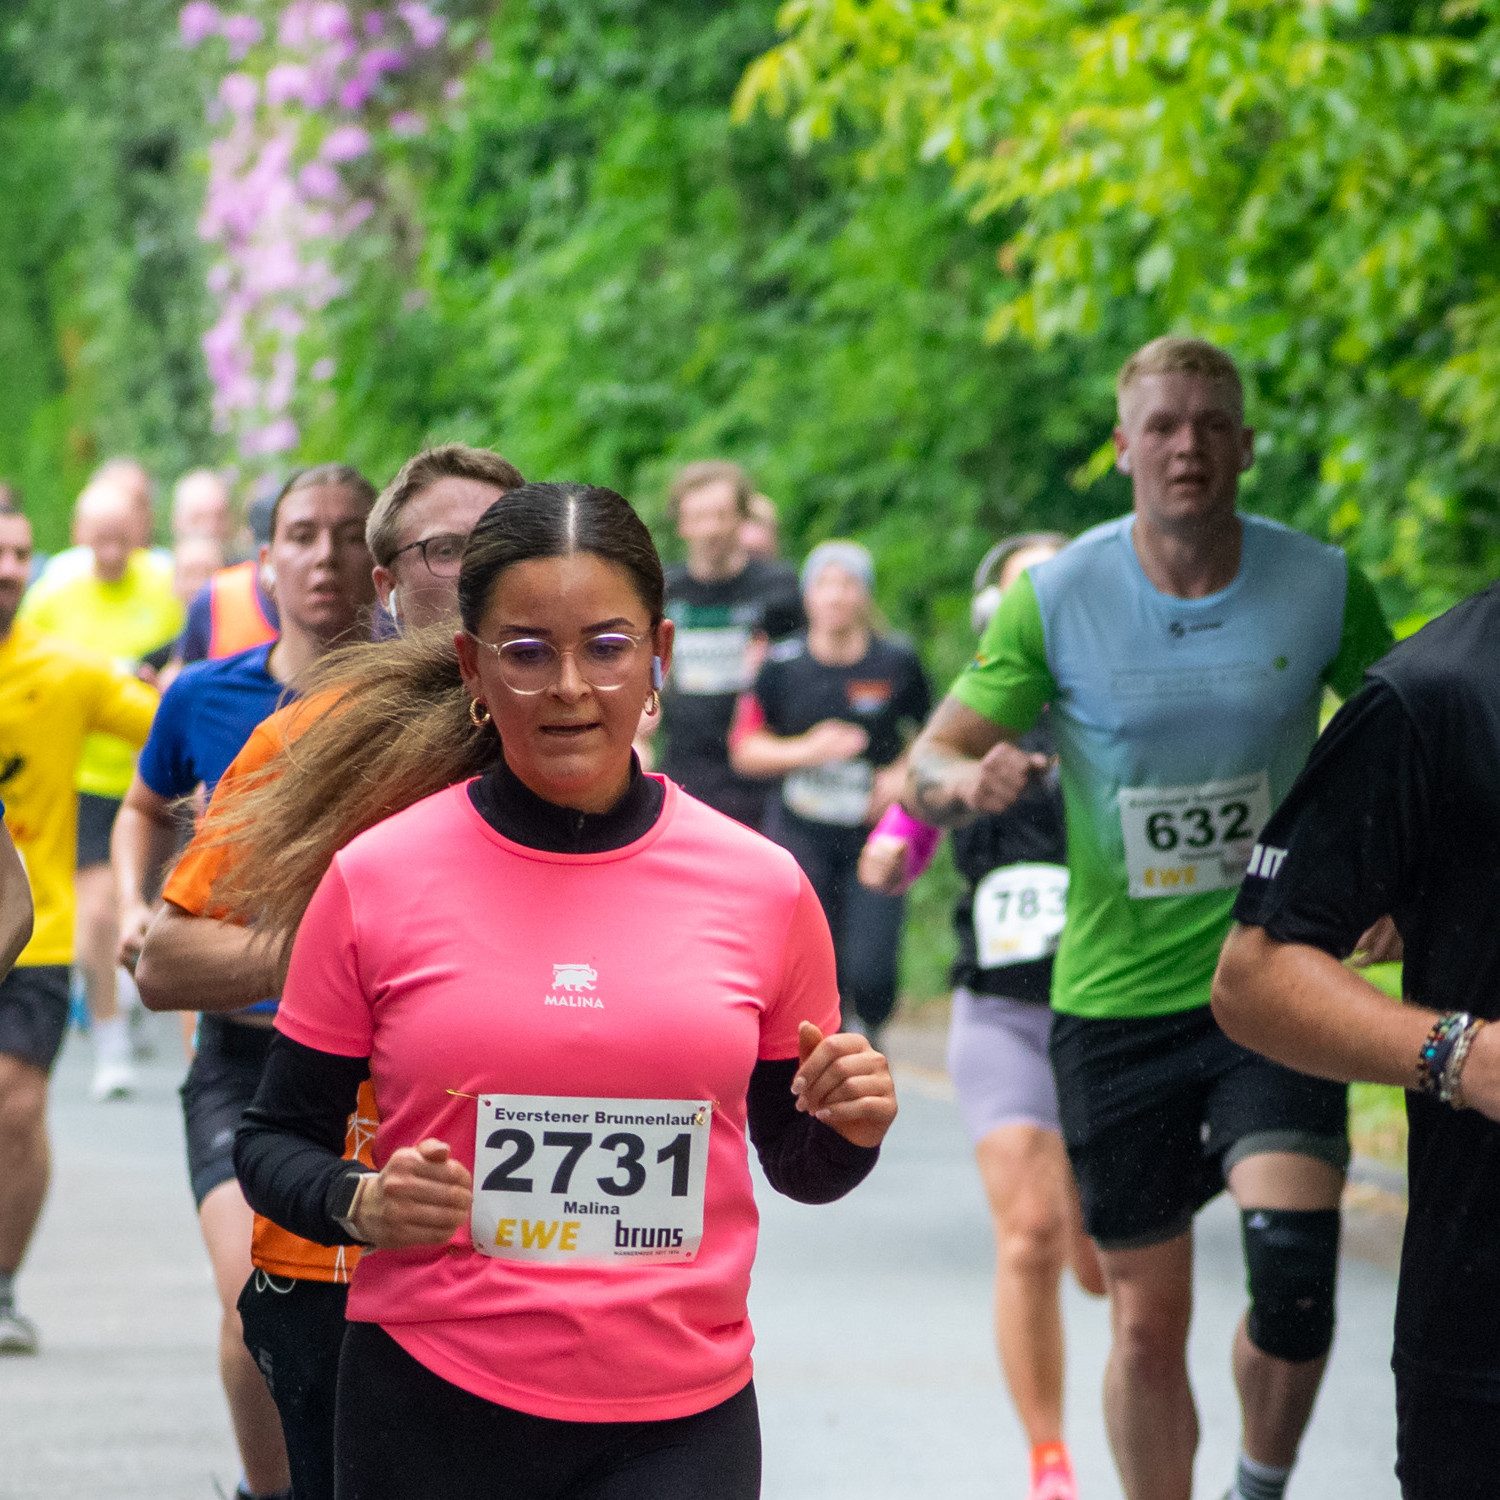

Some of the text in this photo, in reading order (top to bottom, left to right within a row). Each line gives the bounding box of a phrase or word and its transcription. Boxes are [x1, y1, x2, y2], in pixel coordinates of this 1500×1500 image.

[1145, 801, 1253, 852] 632
[993, 887, 1066, 925] 783
[544, 994, 604, 1009] MALINA
[495, 1108, 697, 1126] Everstener Brunnenlauf
[481, 1128, 692, 1197] 2731
[563, 1201, 620, 1215] Malina
[494, 1218, 683, 1251] EWE bruns
